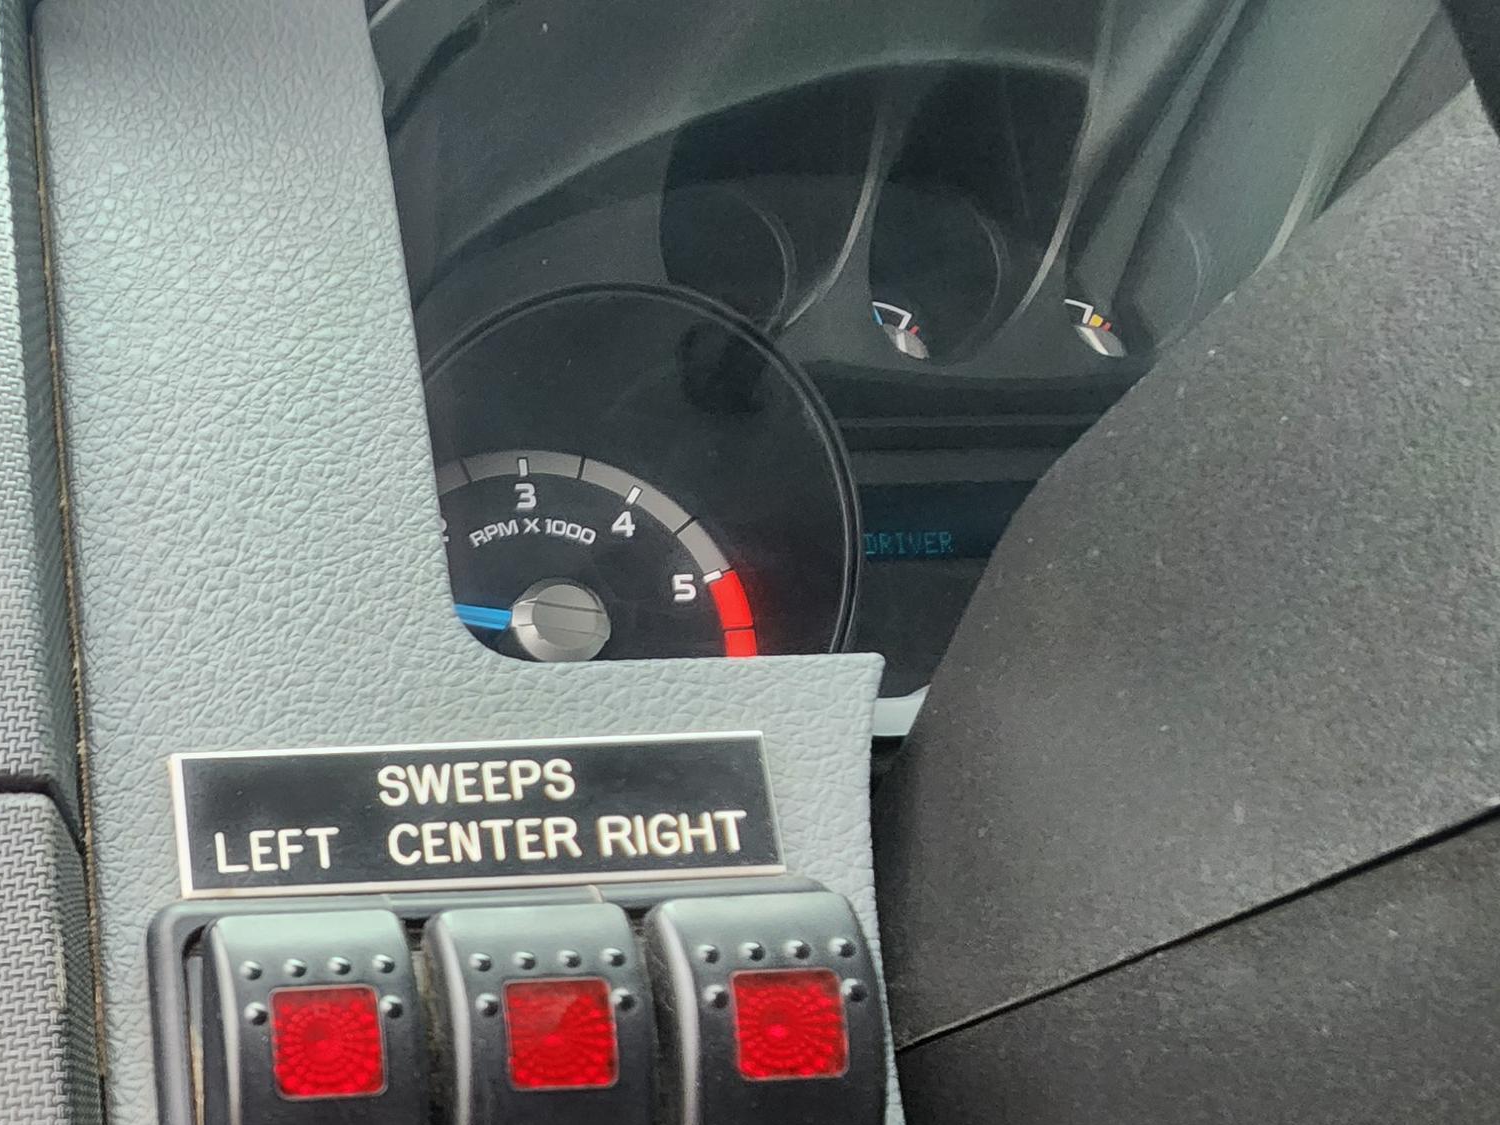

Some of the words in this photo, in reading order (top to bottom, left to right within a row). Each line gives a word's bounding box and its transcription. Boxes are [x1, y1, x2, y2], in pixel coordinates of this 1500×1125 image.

[514, 483, 537, 509] 3
[469, 519, 518, 547] RPM
[545, 518, 597, 545] 1000
[611, 511, 636, 537] 4
[863, 531, 954, 554] DRIVER
[672, 573, 697, 601] 5
[378, 758, 576, 806] SWEEPS
[214, 827, 340, 873] LEFT
[388, 817, 582, 865] CENTER
[597, 809, 747, 857] RIGHT
